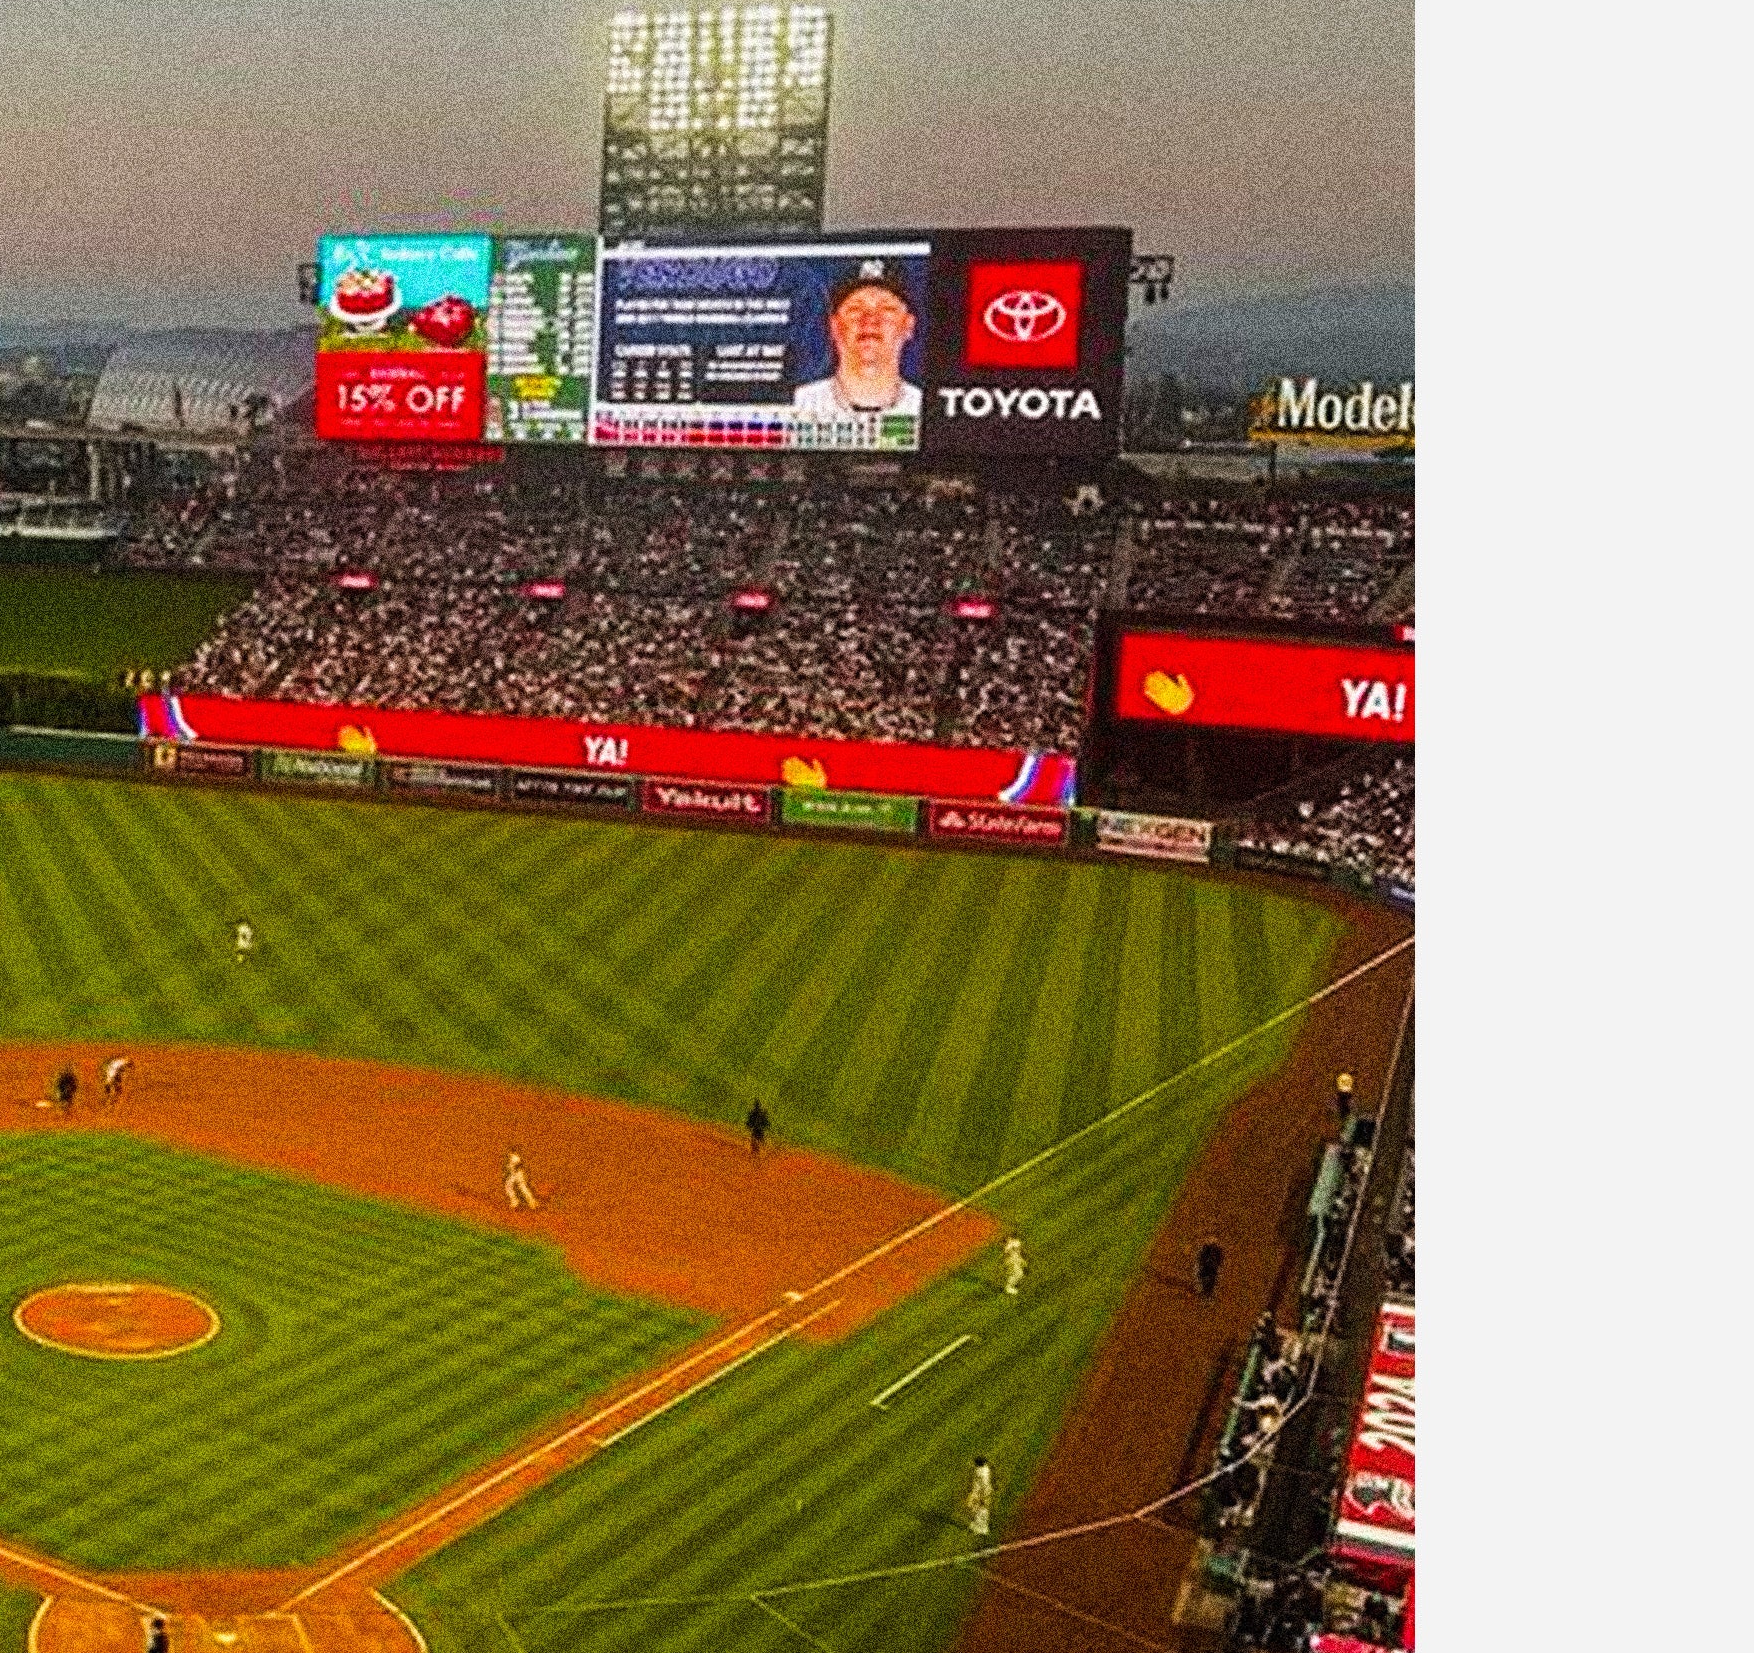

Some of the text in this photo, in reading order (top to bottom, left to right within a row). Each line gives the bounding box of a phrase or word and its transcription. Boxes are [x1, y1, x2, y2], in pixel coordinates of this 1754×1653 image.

[338, 383, 465, 414] 15% OFF
[939, 387, 1102, 420] TOYOTA
[1274, 377, 1415, 432] Model
[1341, 677, 1408, 723] YA!
[583, 734, 629, 767] YA!
[654, 786, 762, 813] Yakult
